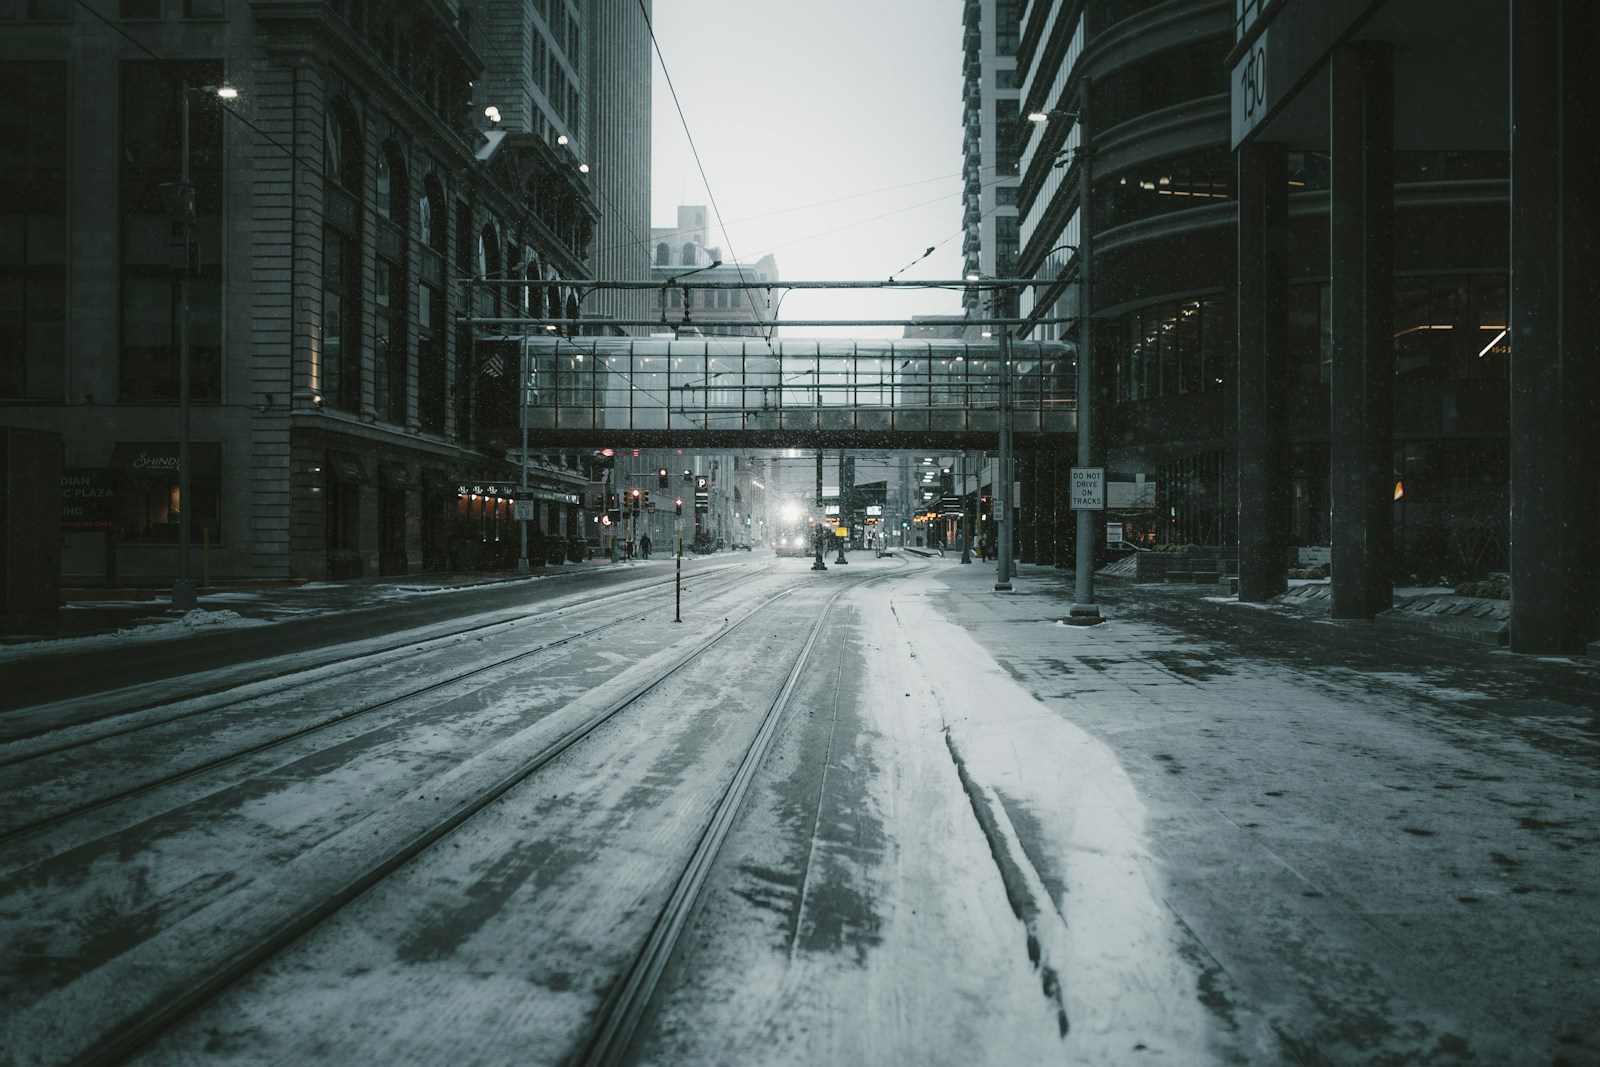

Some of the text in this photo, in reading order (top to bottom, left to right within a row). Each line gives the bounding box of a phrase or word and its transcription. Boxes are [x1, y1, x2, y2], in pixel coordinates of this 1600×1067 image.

[1241, 46, 1265, 121] 150
[1073, 472, 1101, 480] DO NOT
[60, 476, 91, 486] DIAN
[1076, 480, 1098, 488] DRIVE
[74, 487, 114, 497] PLAZA
[1072, 497, 1102, 505] TRACKS
